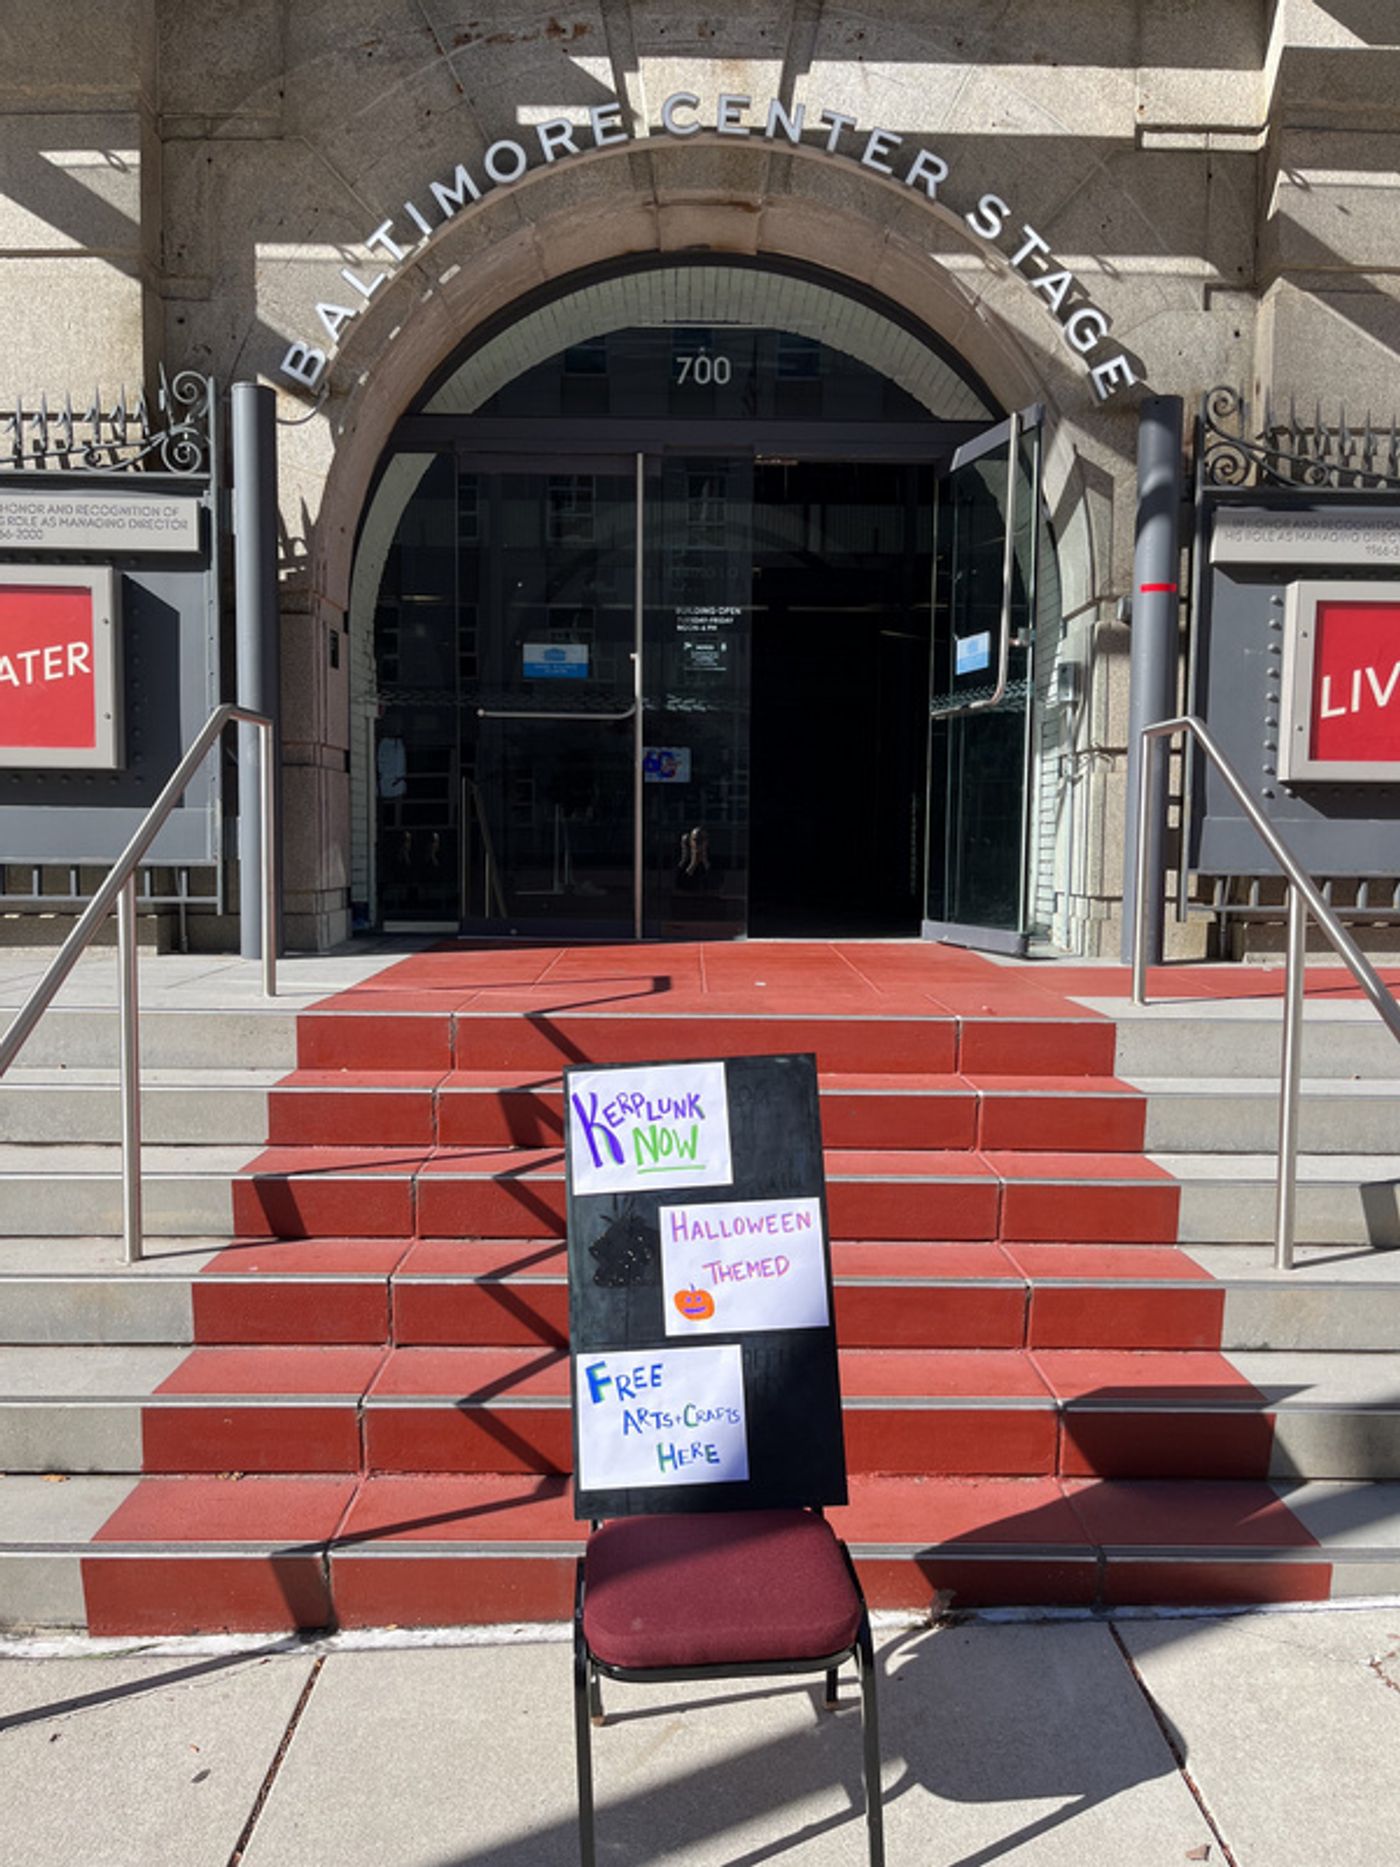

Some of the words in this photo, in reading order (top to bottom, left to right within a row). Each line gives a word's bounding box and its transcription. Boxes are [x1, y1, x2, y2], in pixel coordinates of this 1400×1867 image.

[280, 102, 628, 387] BALTIMORE
[660, 92, 949, 198] CENTER
[965, 193, 1138, 400] STAGE
[676, 356, 731, 385] 700
[0, 503, 45, 514] HONOR
[47, 503, 73, 515] AND
[75, 504, 160, 516] RECOGNITION
[163, 506, 179, 517] OF
[7, 515, 37, 526] ROLE
[40, 516, 56, 528] AS
[59, 517, 125, 529] MANAGING
[128, 518, 189, 531] DIRECTOR
[718, 606, 742, 615] OPEN
[0, 641, 92, 687] ATER
[1320, 660, 1400, 719] LIV
[572, 1091, 706, 1168] KERPLUNK
[633, 1124, 699, 1167] NOW
[670, 1210, 812, 1243] HALLOWEEN
[702, 1254, 790, 1286] THEMED
[585, 1360, 664, 1404] FREE
[656, 1441, 721, 1473] HERE
